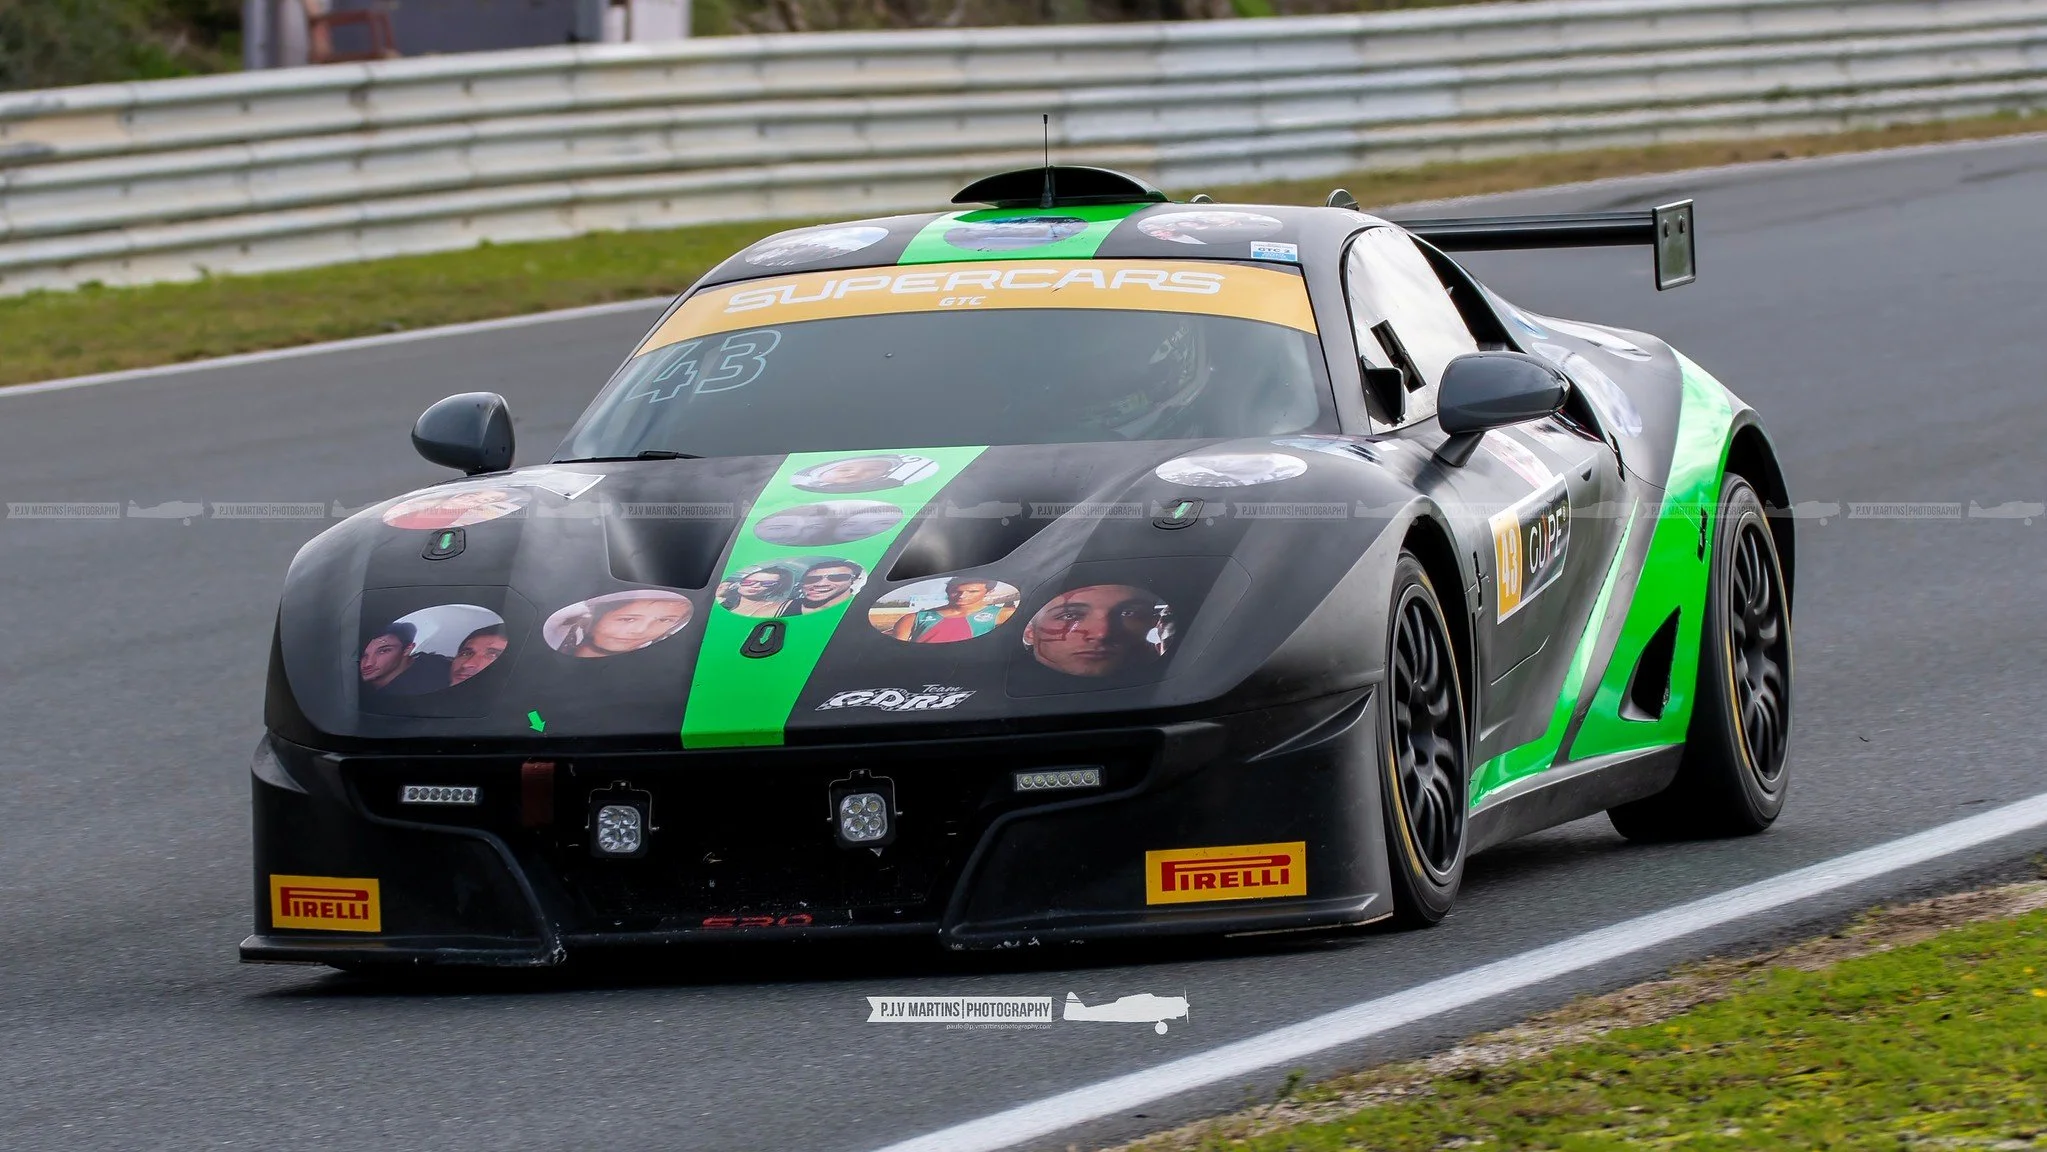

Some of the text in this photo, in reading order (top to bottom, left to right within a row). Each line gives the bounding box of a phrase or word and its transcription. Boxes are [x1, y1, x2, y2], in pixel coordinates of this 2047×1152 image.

[724, 269, 1225, 313] SUPERCARS
[939, 296, 986, 306] GTC
[625, 329, 782, 404] 43
[1501, 528, 1518, 598] 43
[923, 684, 963, 694] Team
[1161, 854, 1291, 892] PIRELLI
[280, 886, 369, 920] PIRELLI
